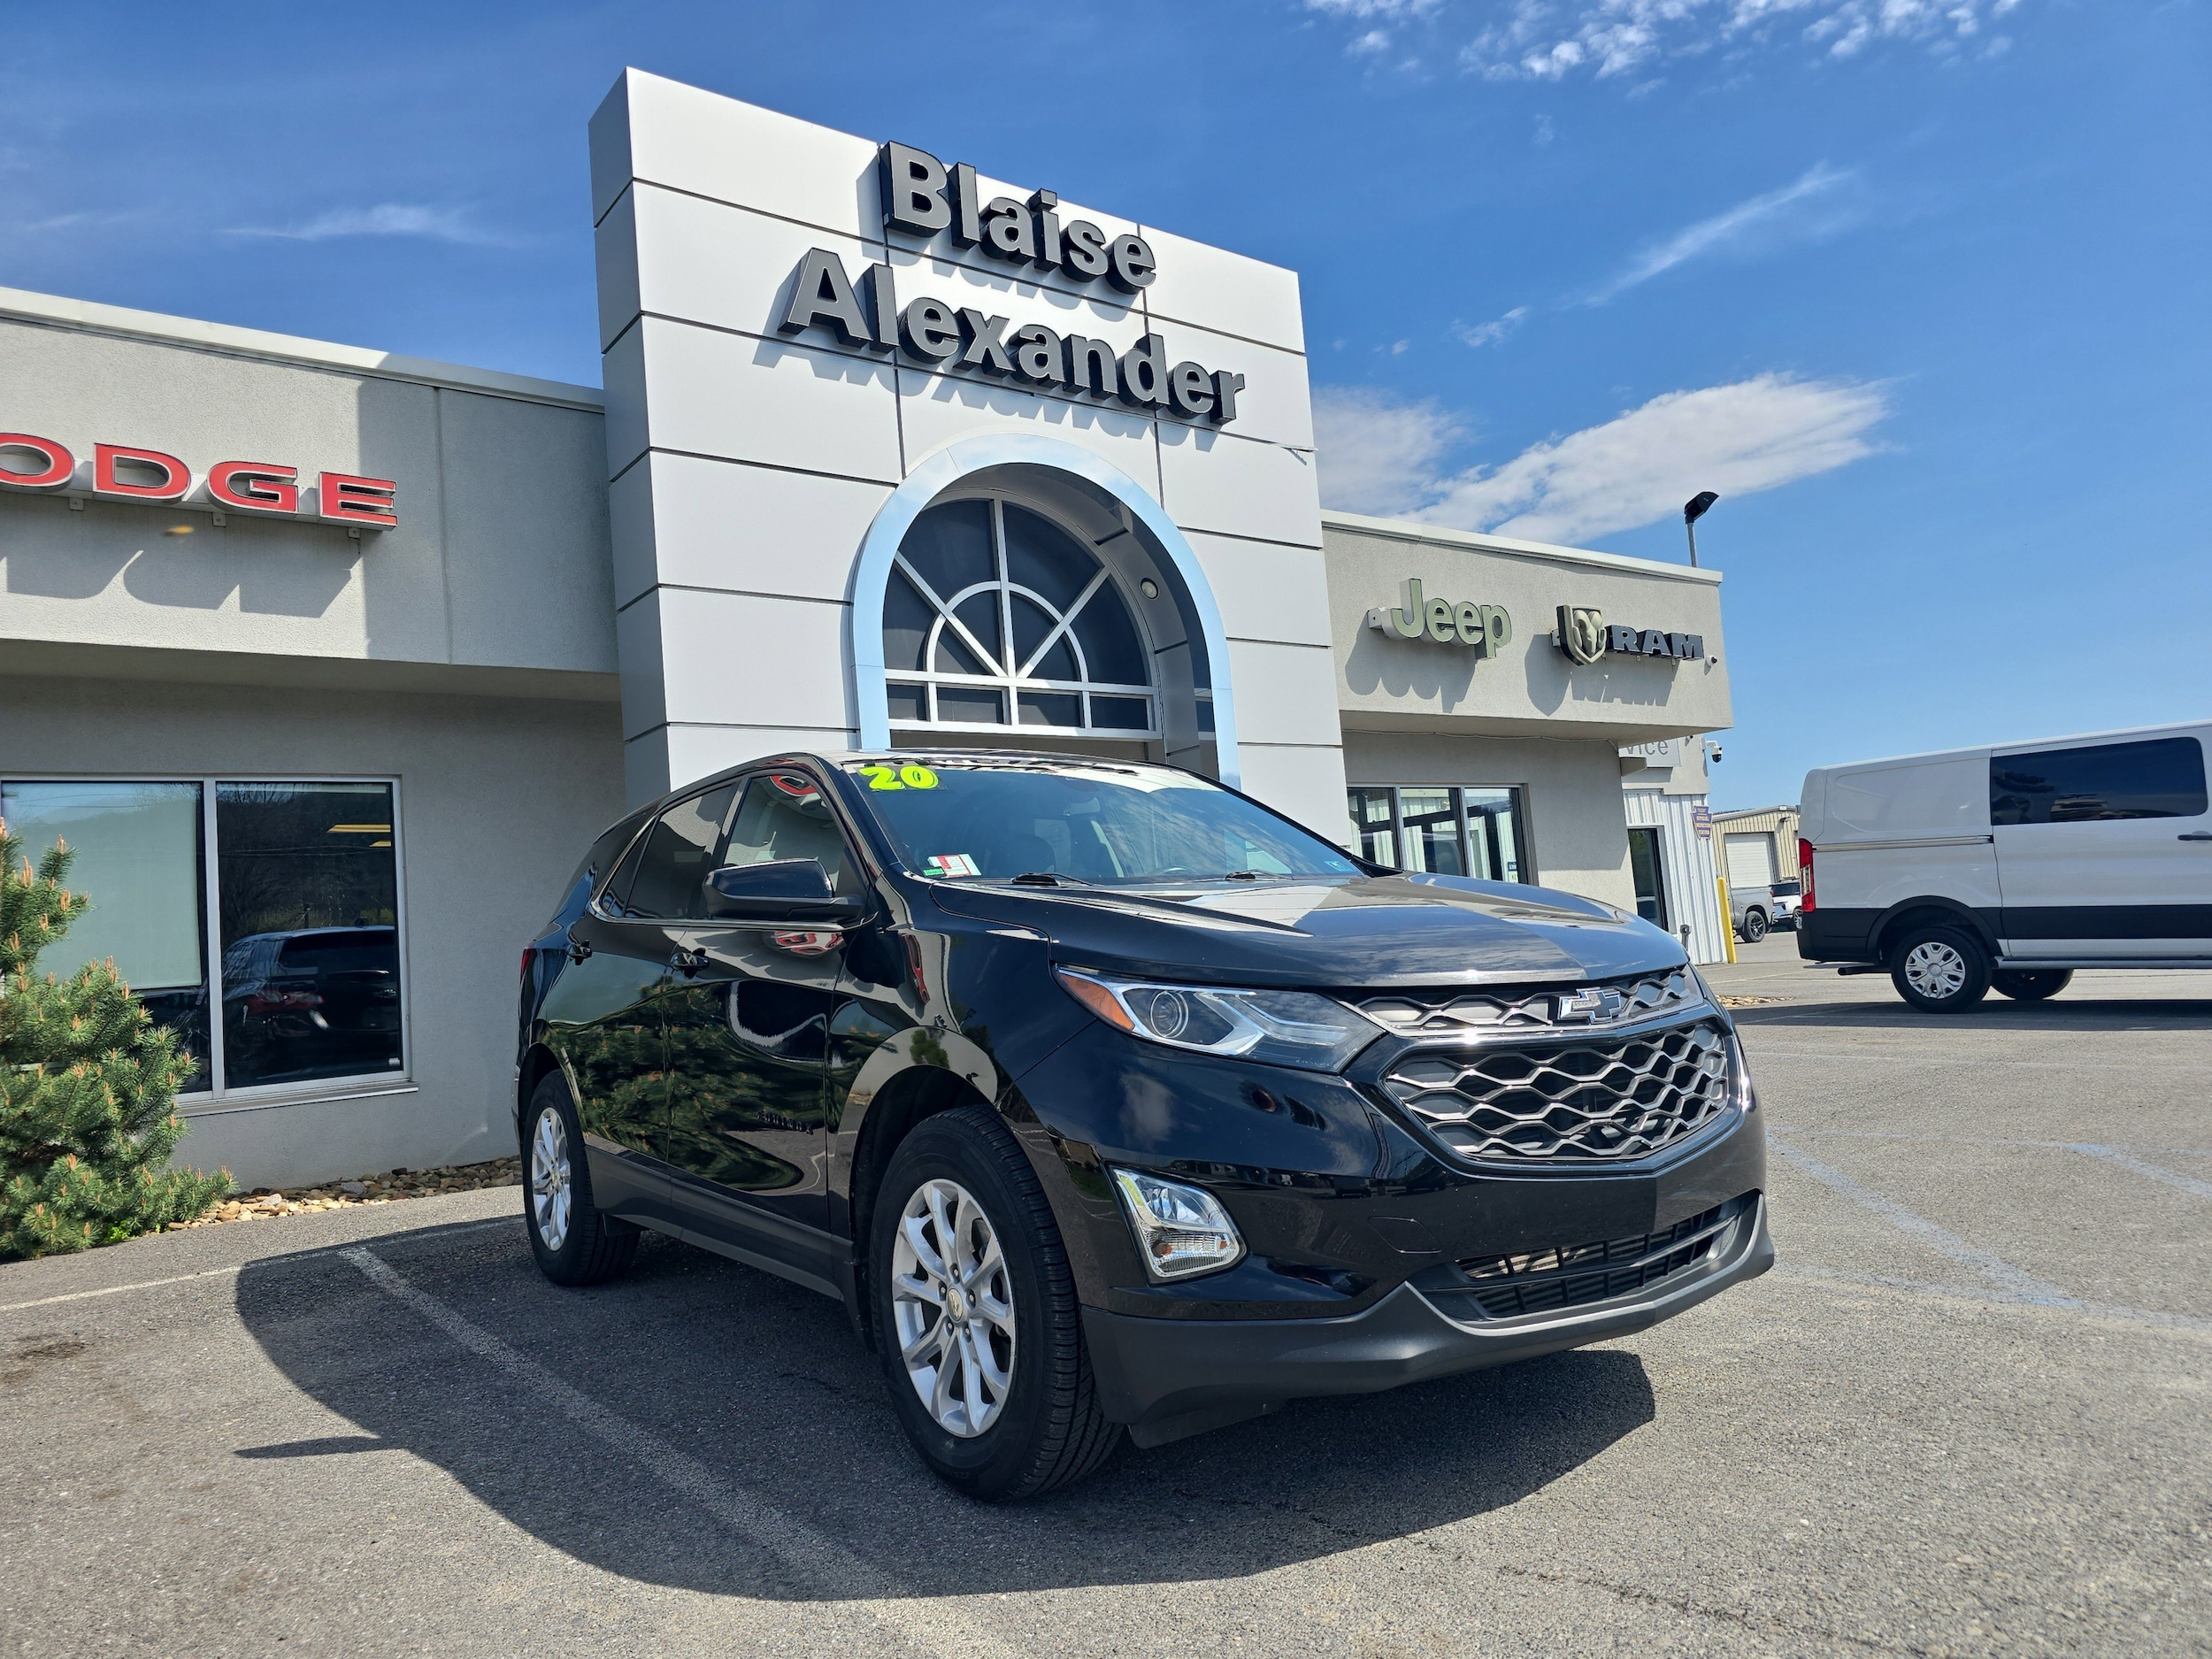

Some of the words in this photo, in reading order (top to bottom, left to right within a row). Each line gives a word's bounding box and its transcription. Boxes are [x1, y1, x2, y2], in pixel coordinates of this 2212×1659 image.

[879, 141, 1156, 294] Blaise
[779, 248, 1245, 425] Alexander
[1382, 578, 1512, 659] Jeep
[1606, 625, 1704, 660] RAM
[859, 765, 939, 791] 20
